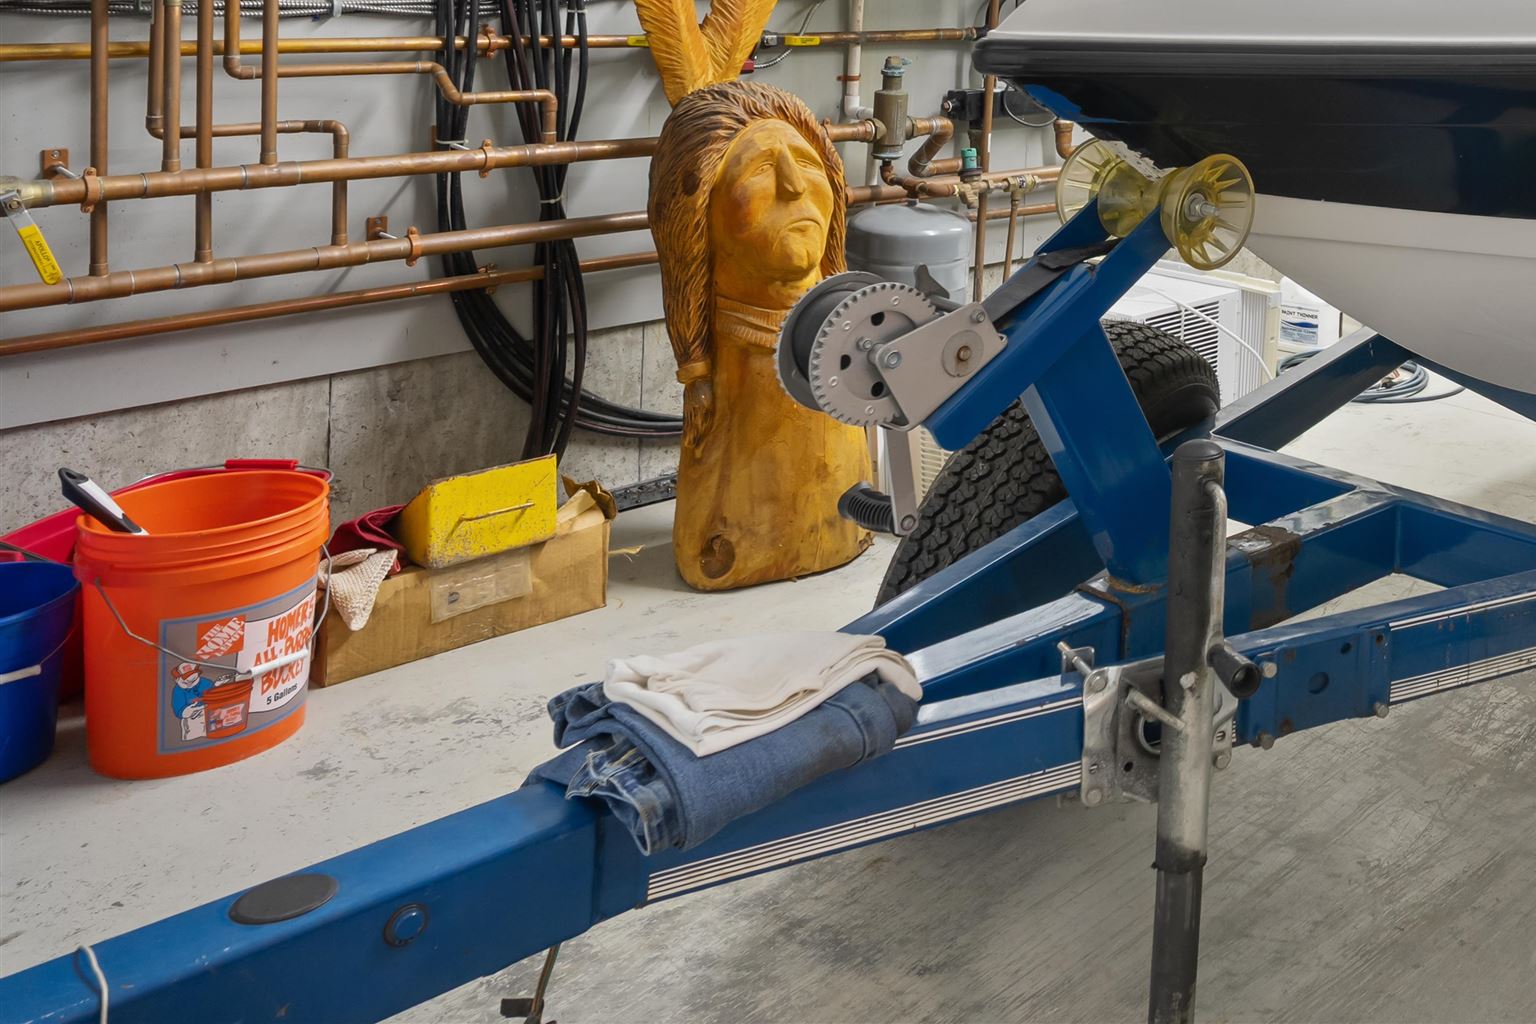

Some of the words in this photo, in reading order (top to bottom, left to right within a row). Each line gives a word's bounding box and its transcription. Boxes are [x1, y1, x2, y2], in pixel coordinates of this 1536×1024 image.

[200, 623, 225, 641] THE
[265, 695, 274, 706] 5
[274, 682, 299, 701] Gallons
